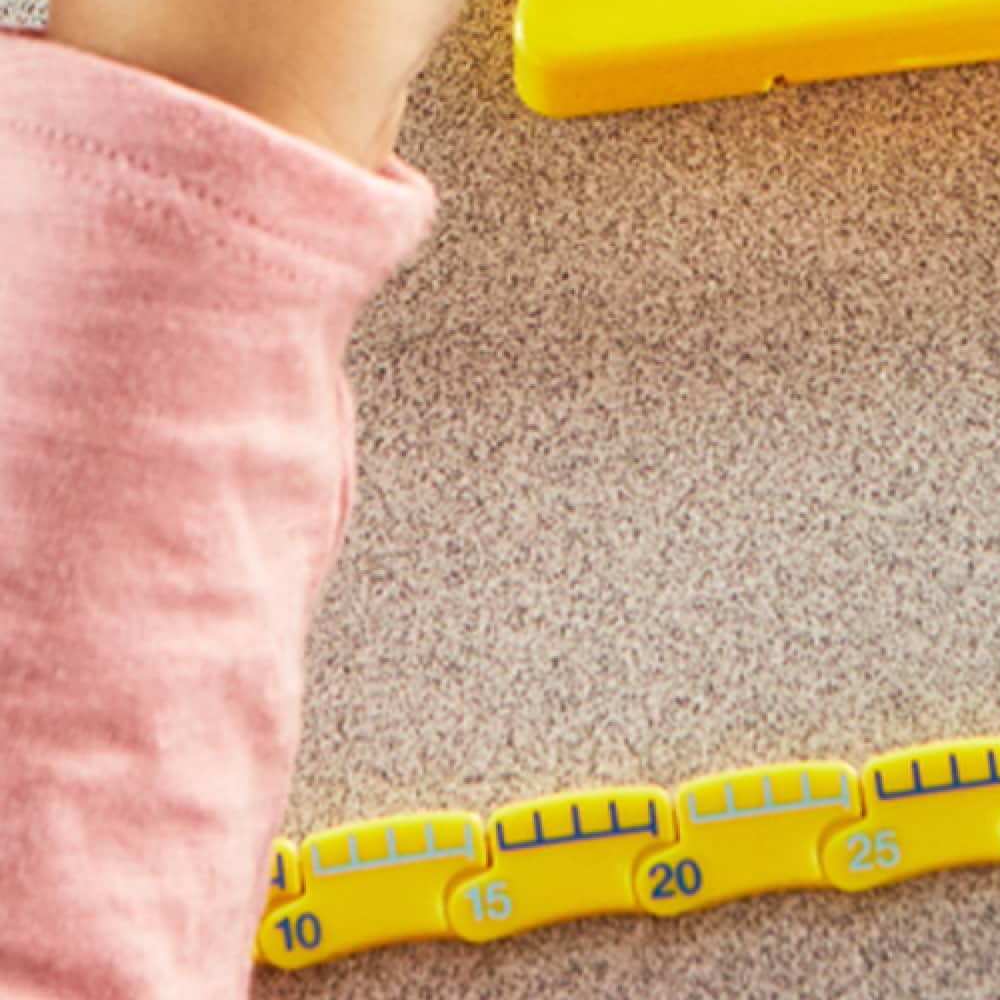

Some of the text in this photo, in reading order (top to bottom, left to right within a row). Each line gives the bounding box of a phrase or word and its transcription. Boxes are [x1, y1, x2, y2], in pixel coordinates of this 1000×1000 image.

[846, 829, 901, 873] 25
[462, 880, 513, 921] 15
[648, 858, 702, 901] 20
[275, 912, 321, 953] 10
